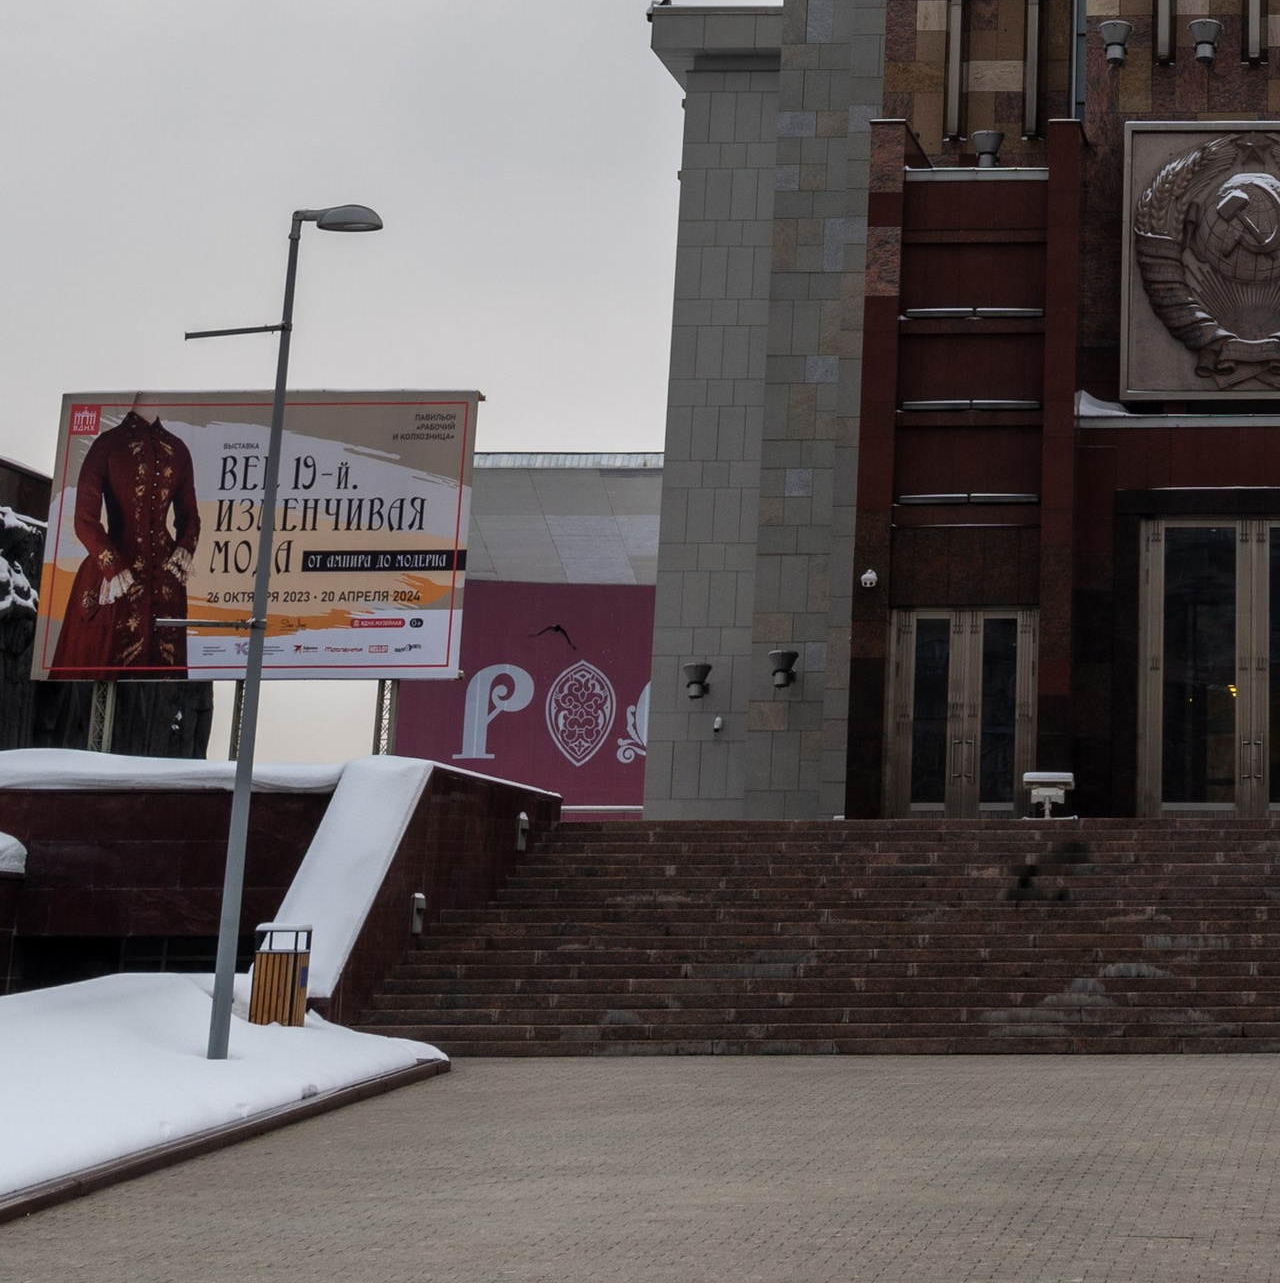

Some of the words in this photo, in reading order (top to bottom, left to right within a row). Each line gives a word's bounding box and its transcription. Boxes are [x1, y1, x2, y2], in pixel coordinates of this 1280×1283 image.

[417, 422, 456, 430] «РАБОЧИЙ
[210, 540, 293, 577] МОА
[308, 556, 322, 567] ОТ
[376, 555, 391, 568] ДО
[396, 554, 447, 567] МОДЕРНА
[207, 592, 219, 603] 26
[223, 591, 279, 603] ОКТЯРЯ
[283, 591, 310, 602] 2023
[321, 591, 334, 602] 20
[338, 591, 389, 602] АПРЕЛЯ
[393, 590, 420, 602] 2024
